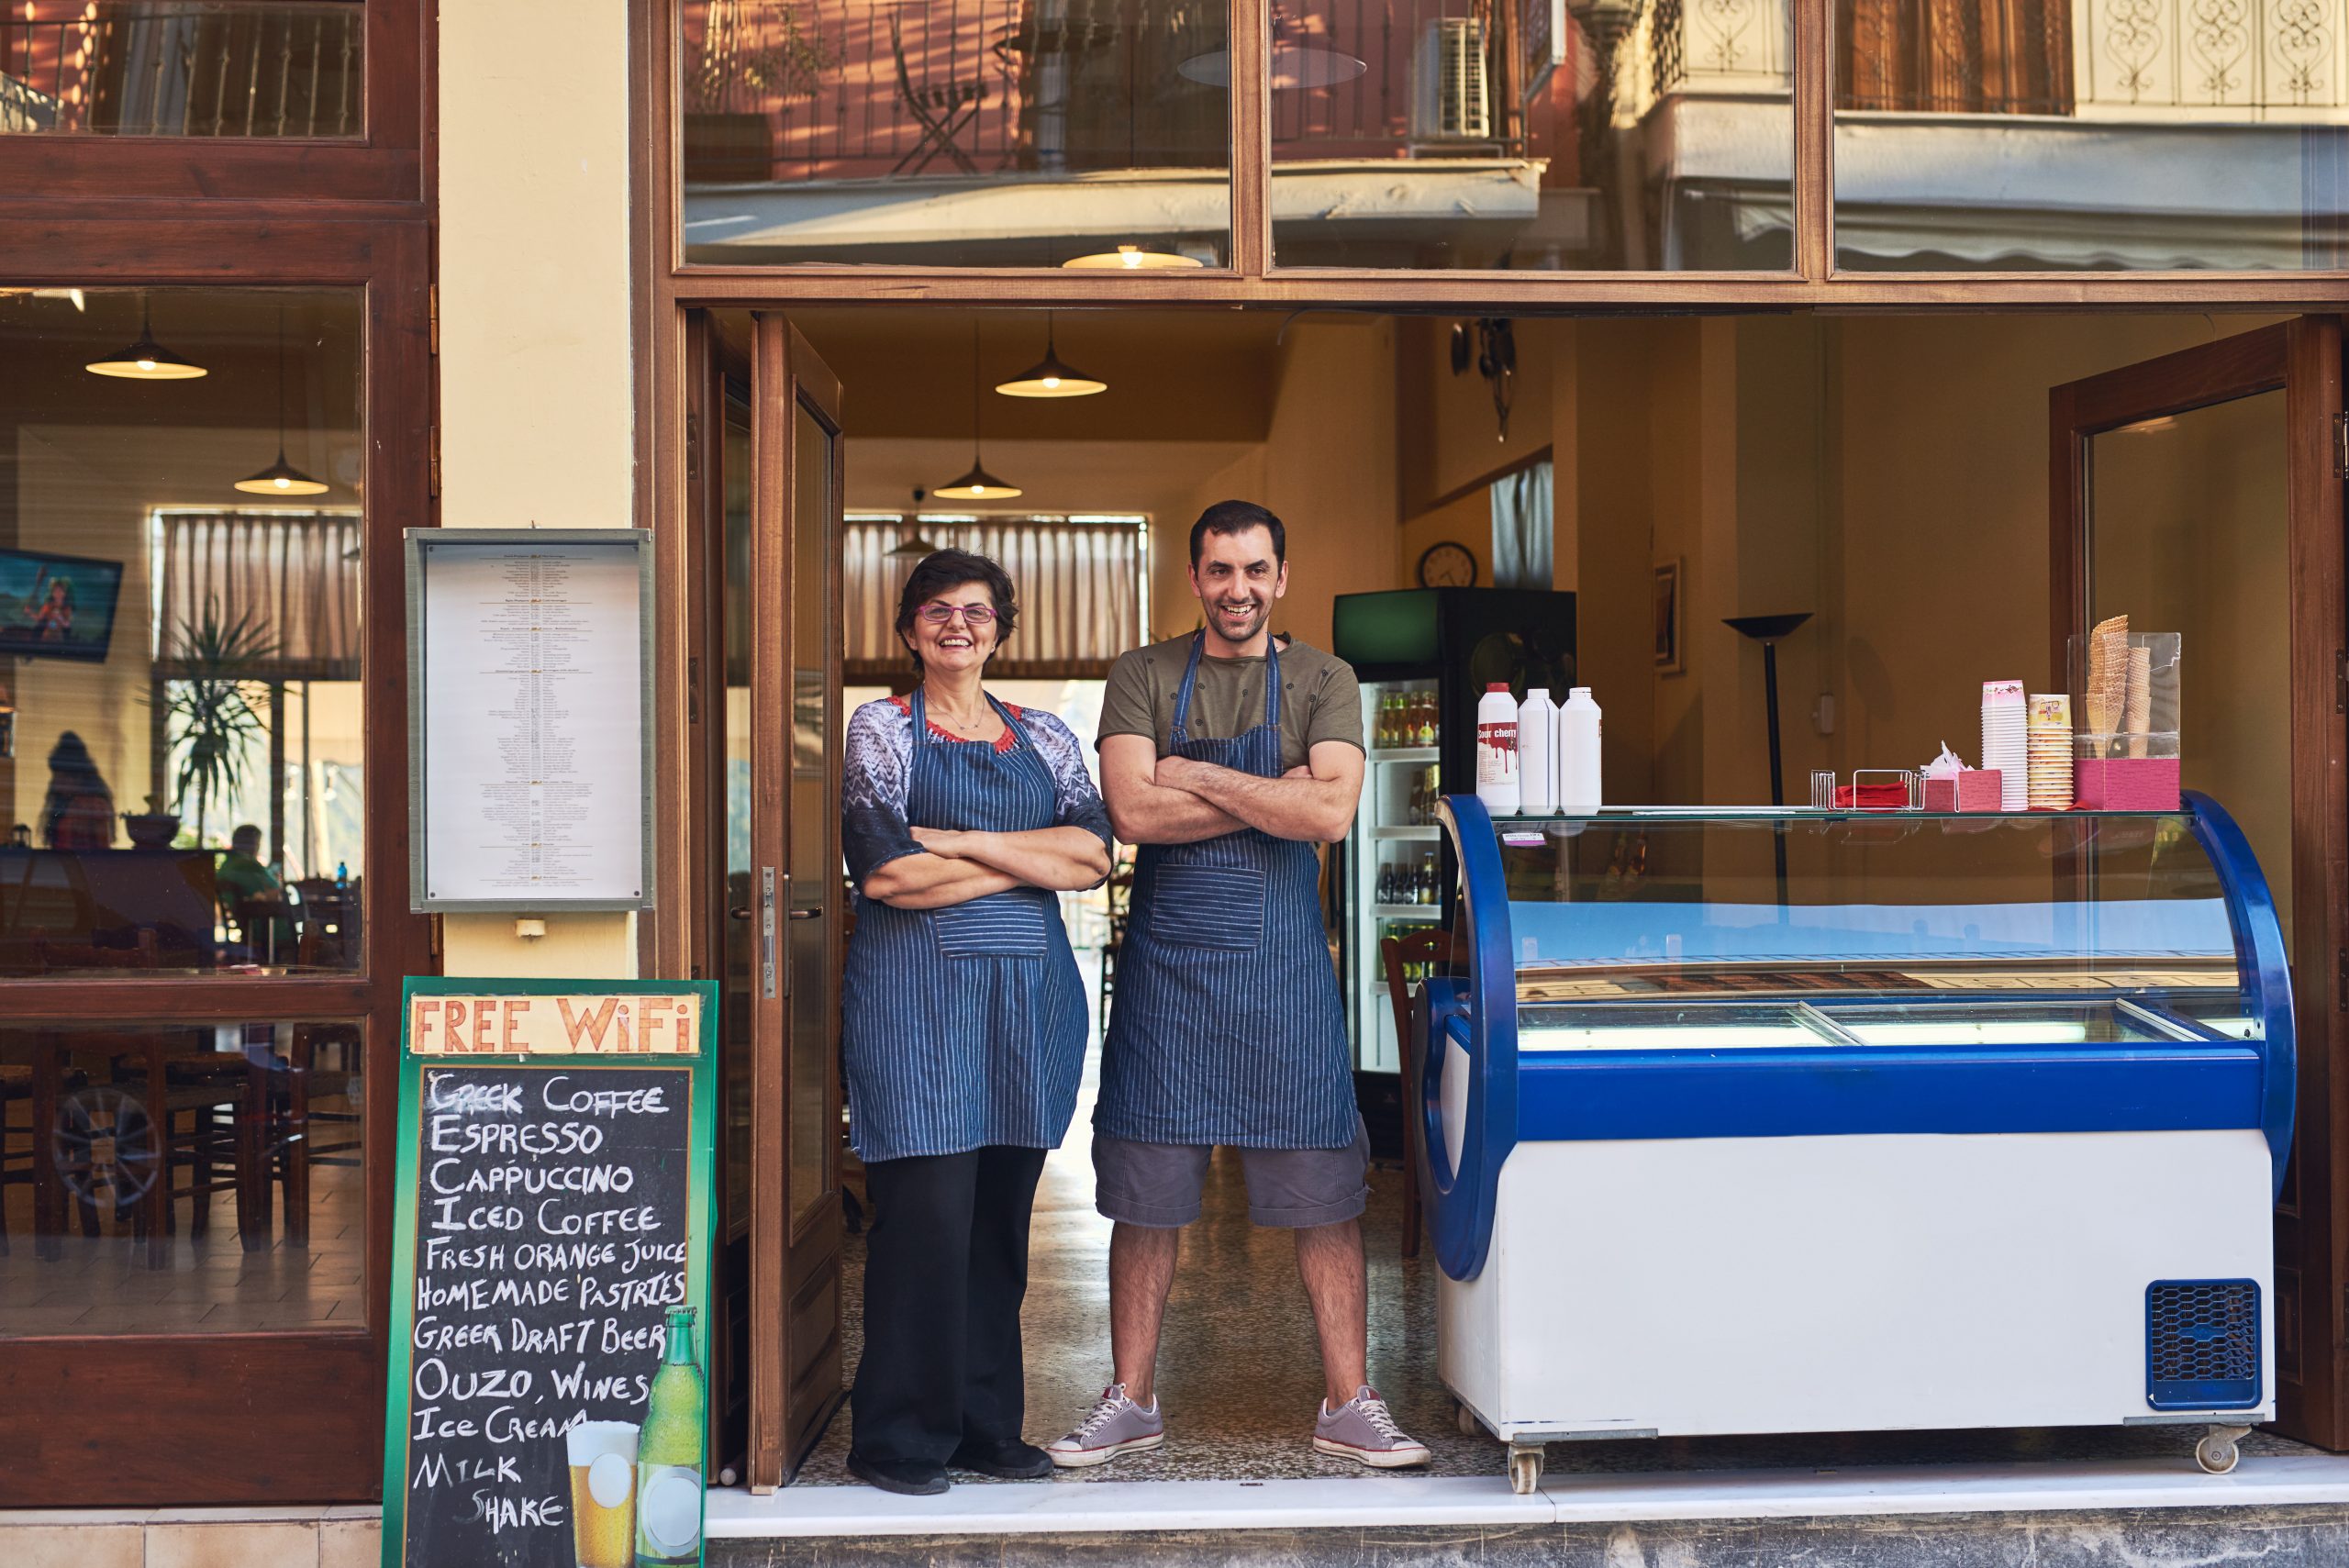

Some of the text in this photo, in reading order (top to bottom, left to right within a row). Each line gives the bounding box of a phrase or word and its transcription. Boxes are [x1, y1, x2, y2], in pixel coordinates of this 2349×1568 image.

[1478, 728, 1517, 740] Sour cherry
[414, 997, 690, 1052] FREE WiFi
[543, 1076, 670, 1118] COFFEE
[431, 1114, 604, 1155] ESPRESSO
[429, 1158, 634, 1195] CAPPUCCINO
[538, 1198, 662, 1235] COFFEE
[427, 1235, 686, 1273] FRESH ORANGE JUICE
[579, 1271, 685, 1313] PASTRIES
[511, 1318, 596, 1354] DRAFT
[601, 1318, 667, 1360] BEER
[551, 1361, 650, 1406] WINES
[413, 1452, 521, 1490] MILK
[452, 1488, 564, 1535] SHAKE
